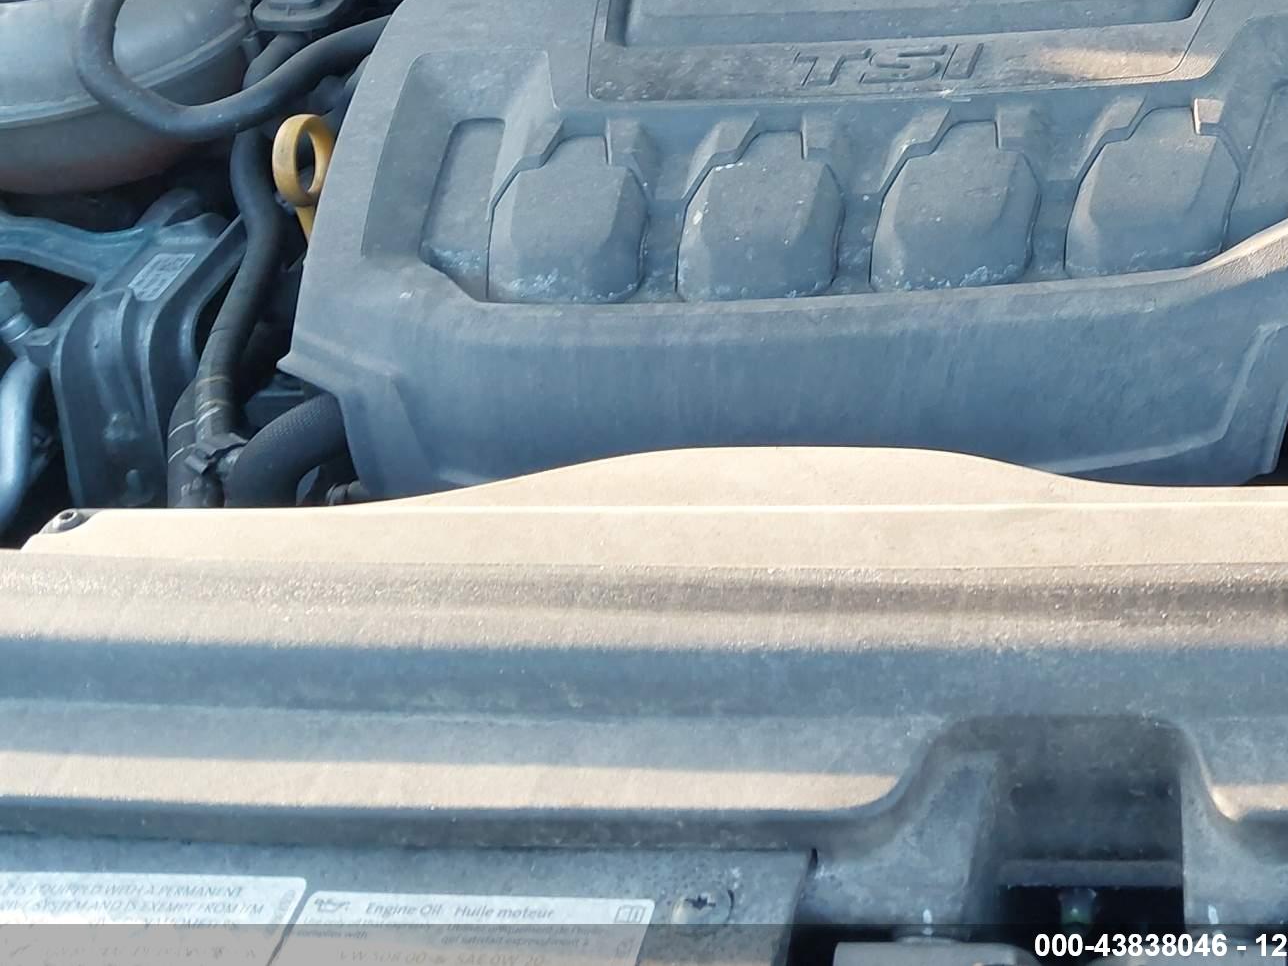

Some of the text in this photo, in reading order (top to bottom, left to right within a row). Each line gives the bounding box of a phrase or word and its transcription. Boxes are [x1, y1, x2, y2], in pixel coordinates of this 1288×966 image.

[793, 43, 984, 86] TSI
[157, 885, 243, 898] PERMANENT
[365, 902, 443, 917] Engine Oil
[454, 905, 554, 919] Huile moteur
